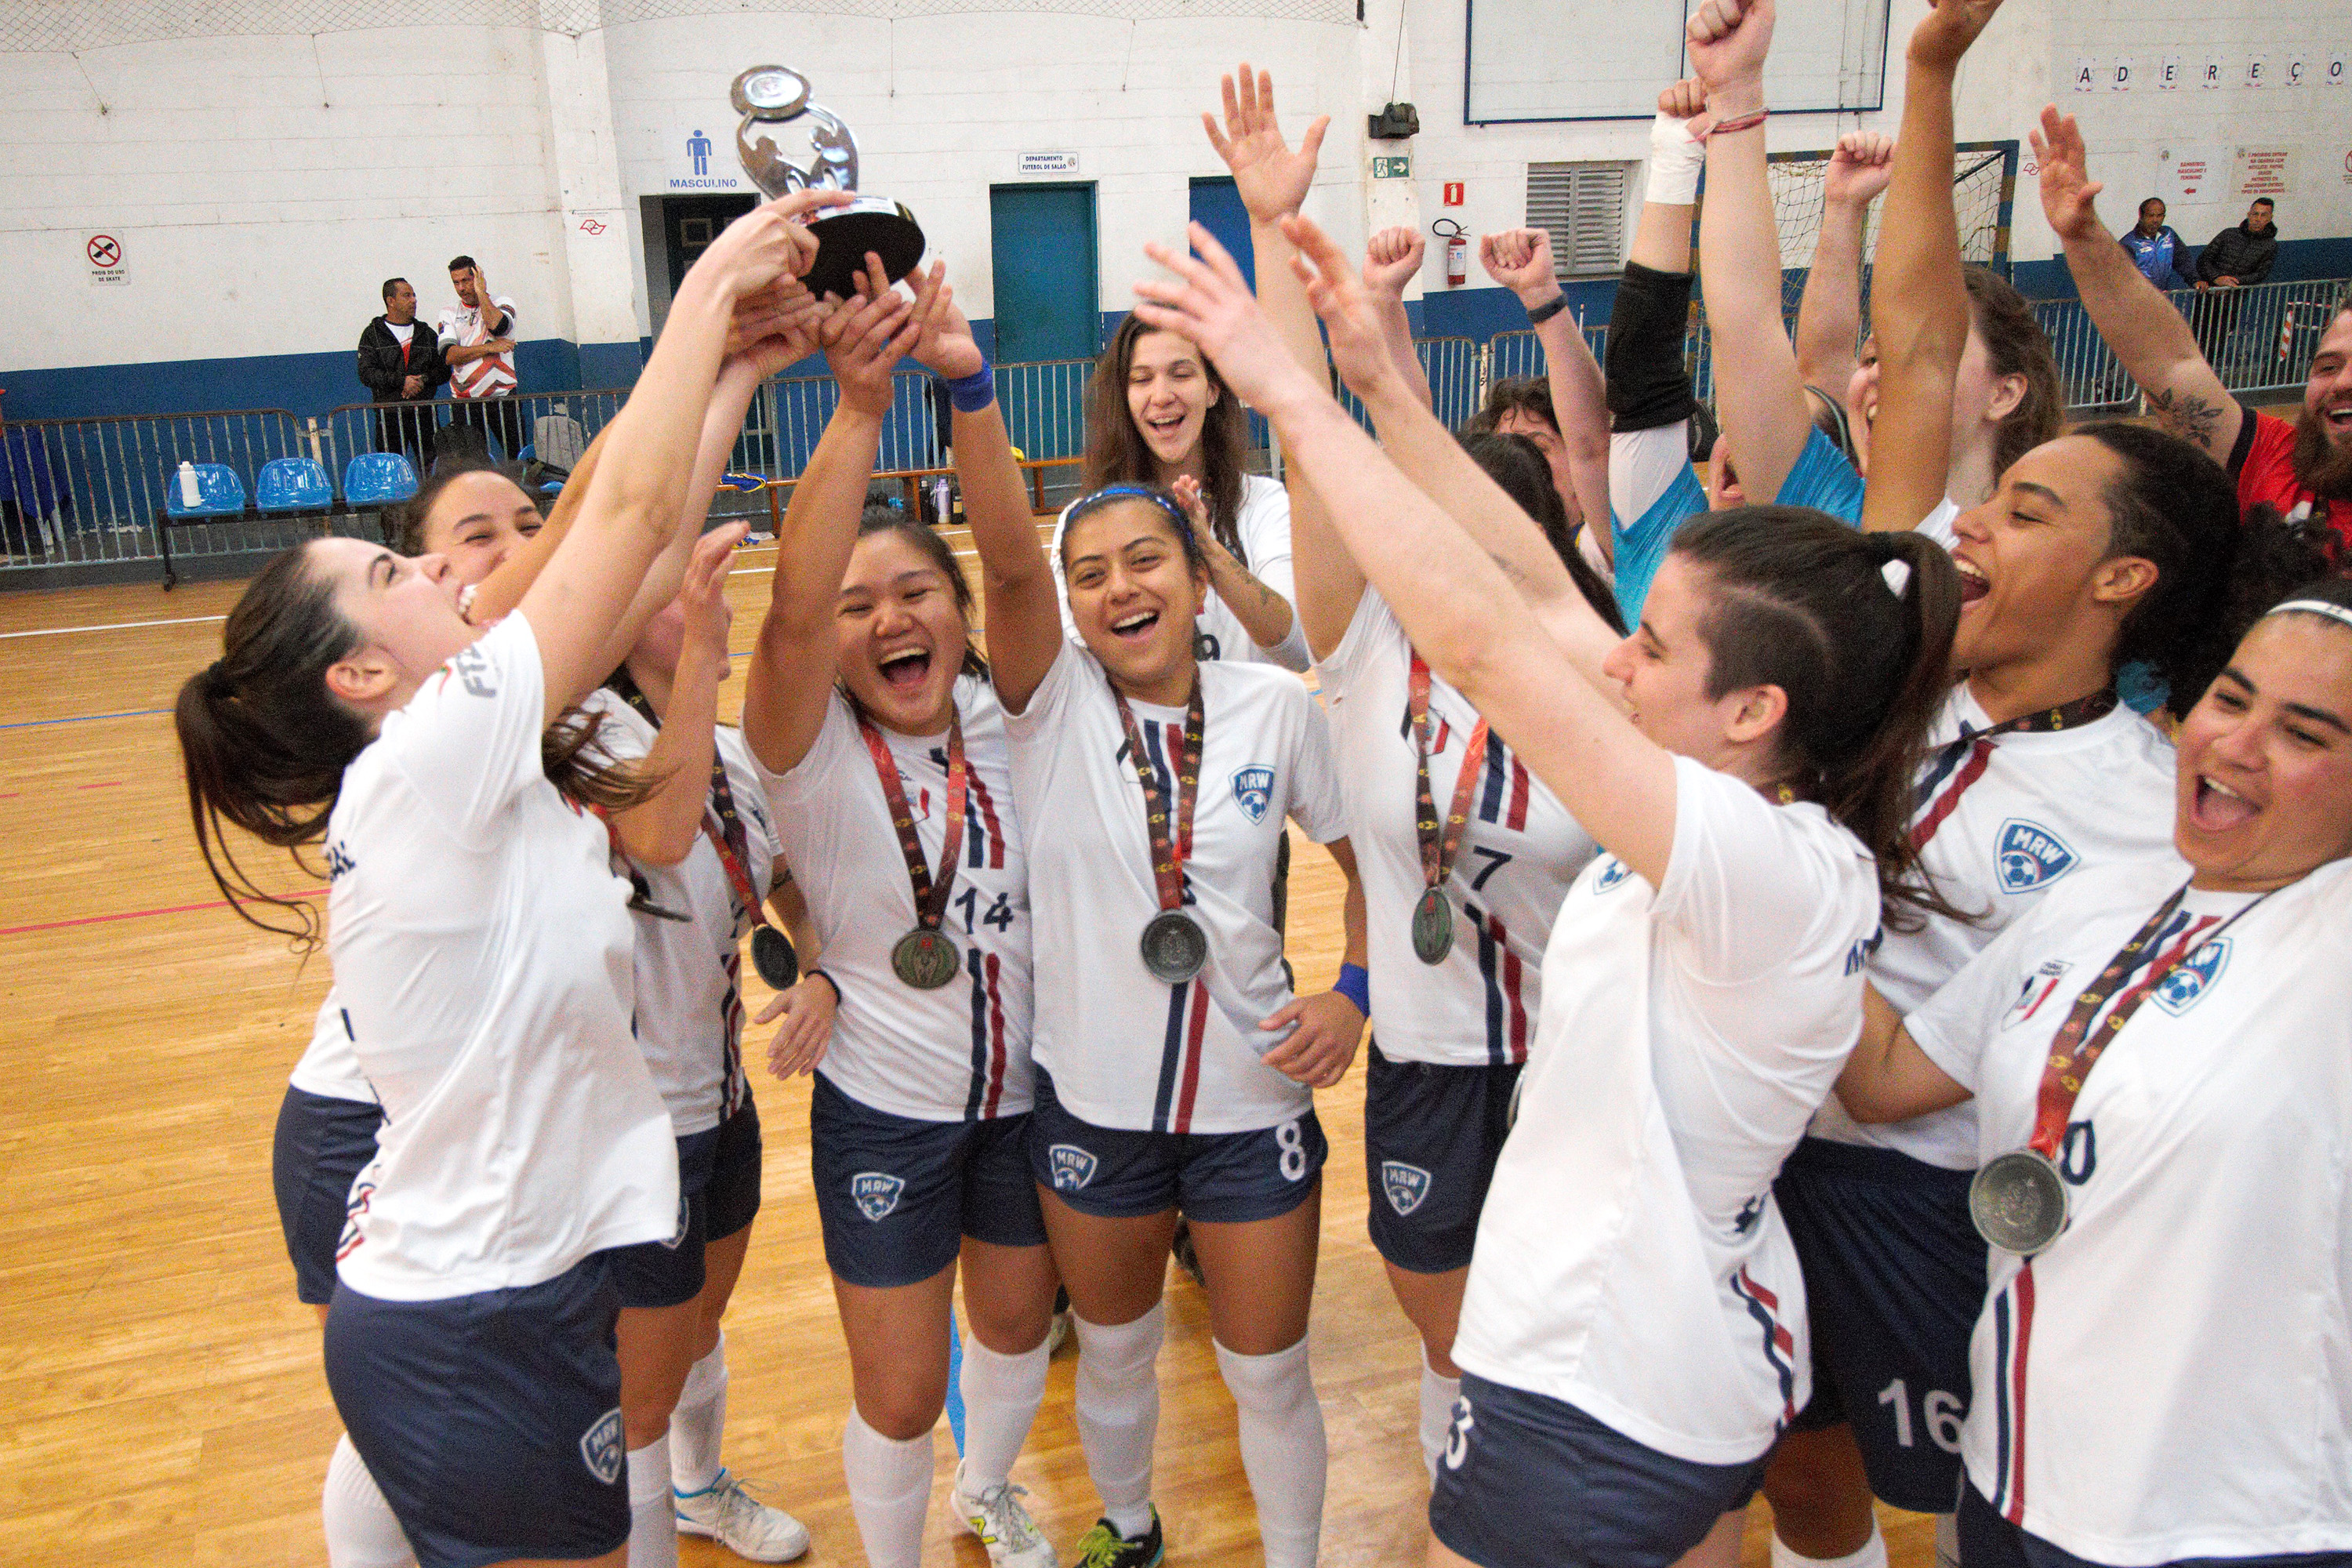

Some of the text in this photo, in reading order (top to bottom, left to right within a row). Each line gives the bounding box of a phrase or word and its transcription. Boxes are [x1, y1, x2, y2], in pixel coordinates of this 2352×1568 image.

[670, 179, 737, 188] MASCULINO
[1470, 844, 1513, 892] 7
[2010, 827, 2066, 866] MRW
[954, 886, 1014, 935] 14
[1056, 1150, 1089, 1170] MRW
[1275, 1120, 1307, 1182] 8
[862, 1179, 895, 1193] MRW
[1877, 1377, 1964, 1454] 16
